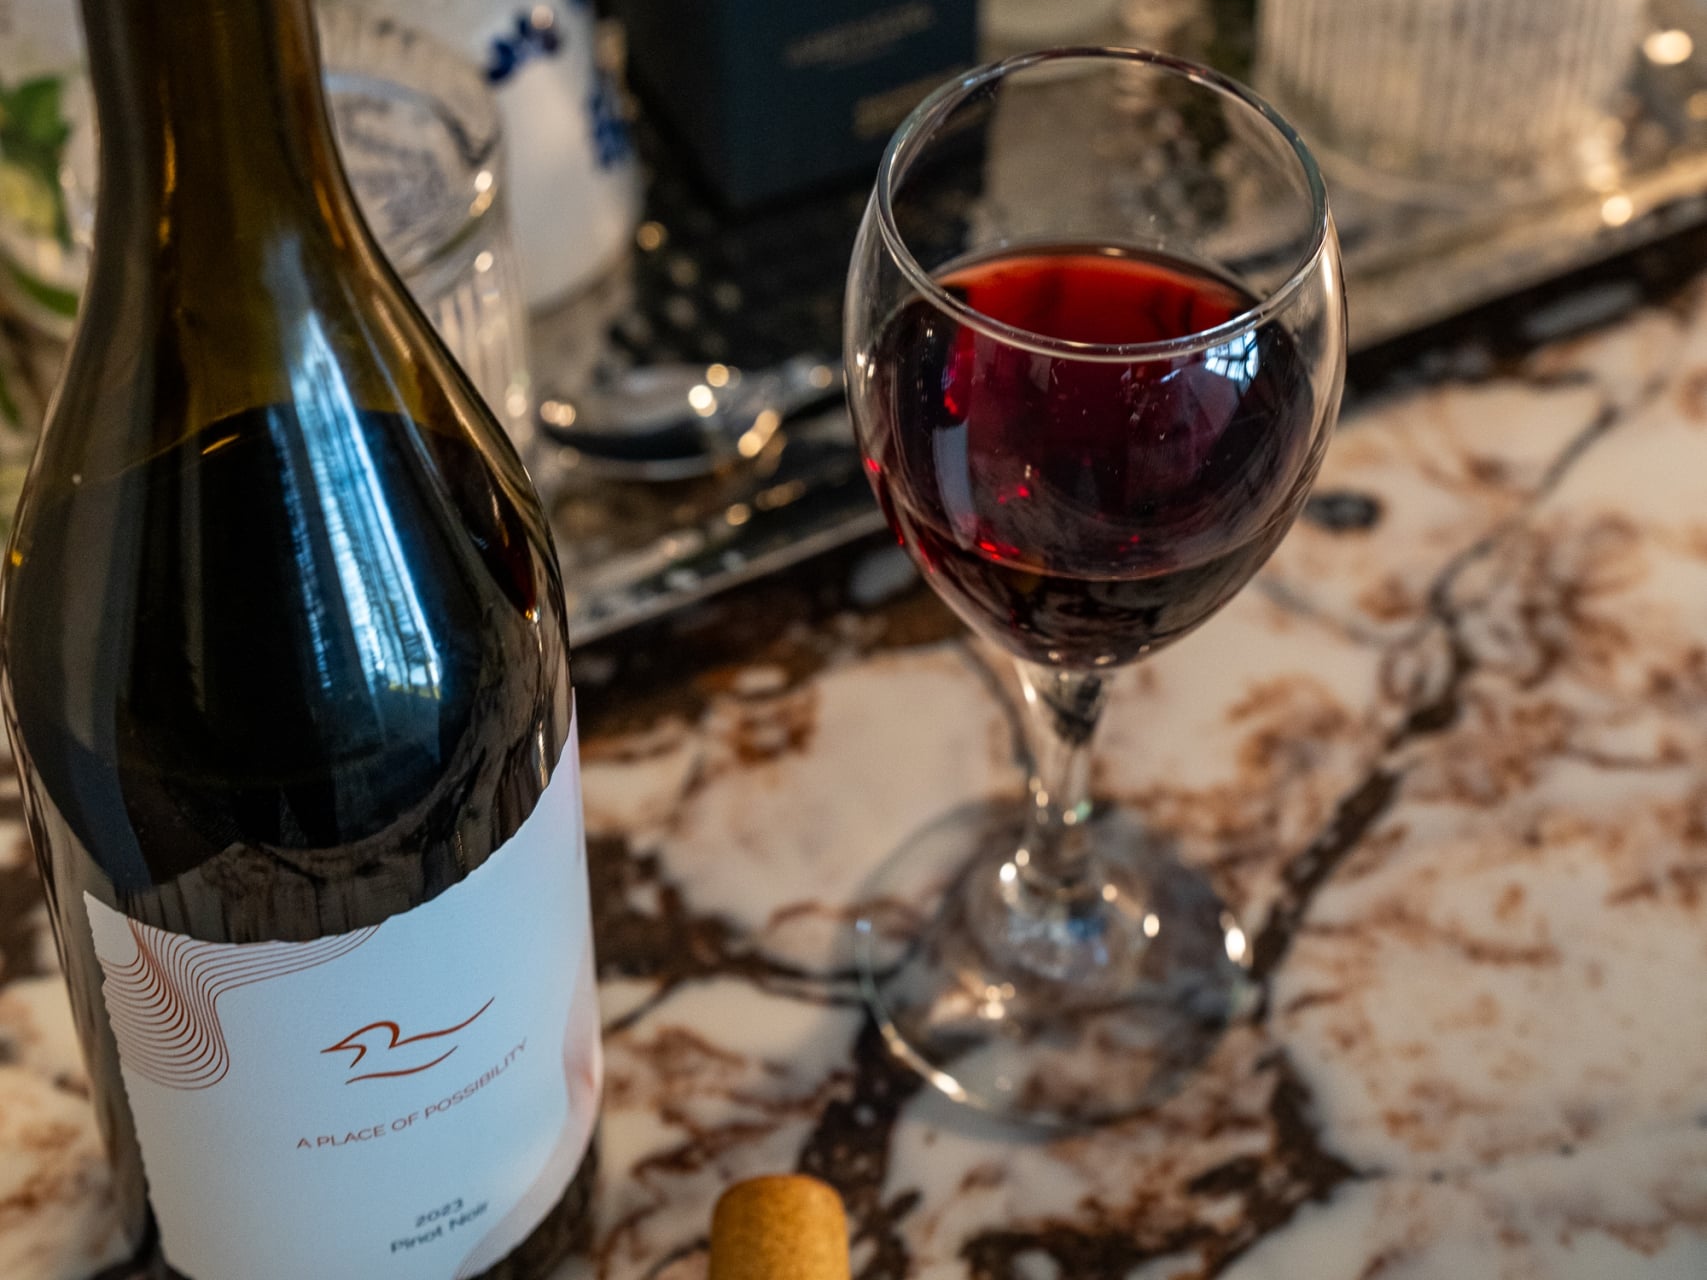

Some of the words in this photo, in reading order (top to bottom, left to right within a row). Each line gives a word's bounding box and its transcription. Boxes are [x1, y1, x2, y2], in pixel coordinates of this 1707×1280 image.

[296, 1137, 313, 1150] A
[316, 1123, 387, 1147] PLACE
[391, 1111, 420, 1132] OF
[425, 1036, 528, 1120] POSSIBILITY
[390, 1225, 443, 1255] Pinot
[448, 1200, 489, 1232] Noir
[415, 1196, 464, 1229] 2023
